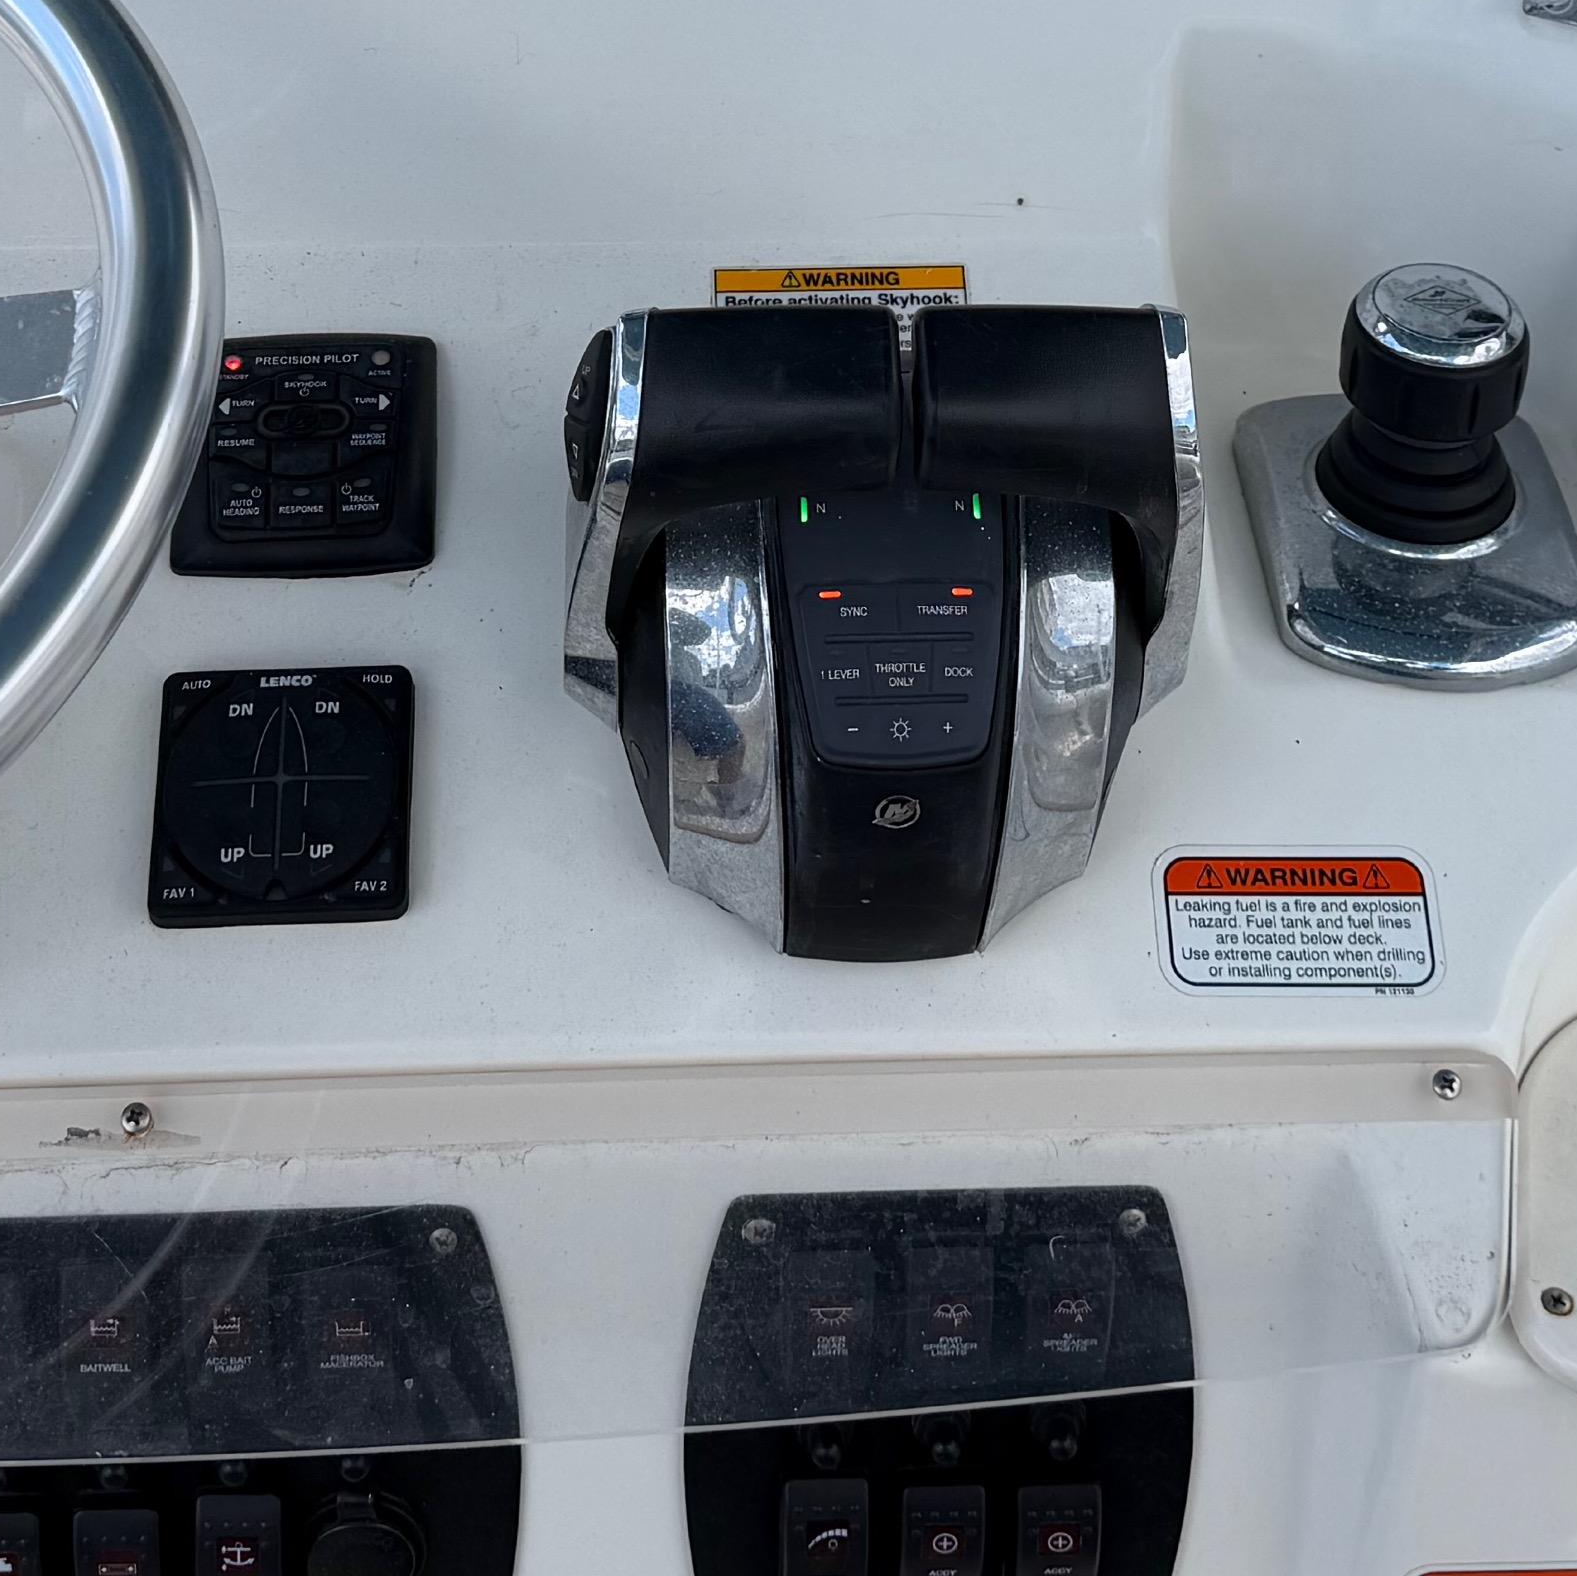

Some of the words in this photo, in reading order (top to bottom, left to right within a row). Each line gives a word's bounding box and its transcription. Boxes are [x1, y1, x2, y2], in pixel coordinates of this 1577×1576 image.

[802, 271, 900, 288] WARNING
[878, 293, 960, 309] Skyhook:
[255, 355, 320, 365] PRECISION
[324, 353, 360, 364] PILOT
[217, 439, 255, 447] RESUME
[278, 505, 324, 514] RESPONSE
[816, 503, 826, 513] N
[840, 606, 868, 617] SYNC
[917, 605, 968, 615] TRANSFER
[828, 669, 860, 680] LEVER
[875, 662, 926, 674] THROTTLE
[944, 667, 973, 677] DOCK
[182, 680, 211, 691] AUTO
[260, 675, 313, 688] LENCO
[362, 674, 393, 684] HOLD
[888, 677, 914, 687] ONLY
[228, 703, 254, 717] DN
[315, 701, 340, 714] DN
[220, 847, 245, 862] UP
[310, 844, 334, 858] UP
[1226, 867, 1358, 887] WARNING
[354, 880, 378, 892] FAV
[163, 888, 186, 899] FAV
[1175, 899, 1231, 914] Leaking
[1235, 899, 1261, 913] fuel
[1294, 899, 1317, 913] fire
[1321, 899, 1348, 913] and
[1352, 899, 1422, 916] explosion
[1189, 915, 1242, 929] hazard.
[1246, 915, 1277, 929] Fuel
[1281, 915, 1312, 929] tank
[1316, 915, 1343, 929] and
[1347, 915, 1373, 929] fuel
[1377, 915, 1411, 929] lines
[1216, 934, 1238, 945] are
[1243, 931, 1296, 945] located
[1301, 931, 1343, 945] below
[1347, 931, 1387, 945] deck.
[1182, 948, 1210, 960] Use
[1214, 949, 1272, 961] extreme
[1276, 948, 1329, 961] caution
[1333, 948, 1373, 961] when
[1377, 948, 1425, 964] drilling
[1228, 964, 1292, 980] installing
[1296, 964, 1402, 980] component(s).
[80, 1363, 131, 1373] BAITWELL
